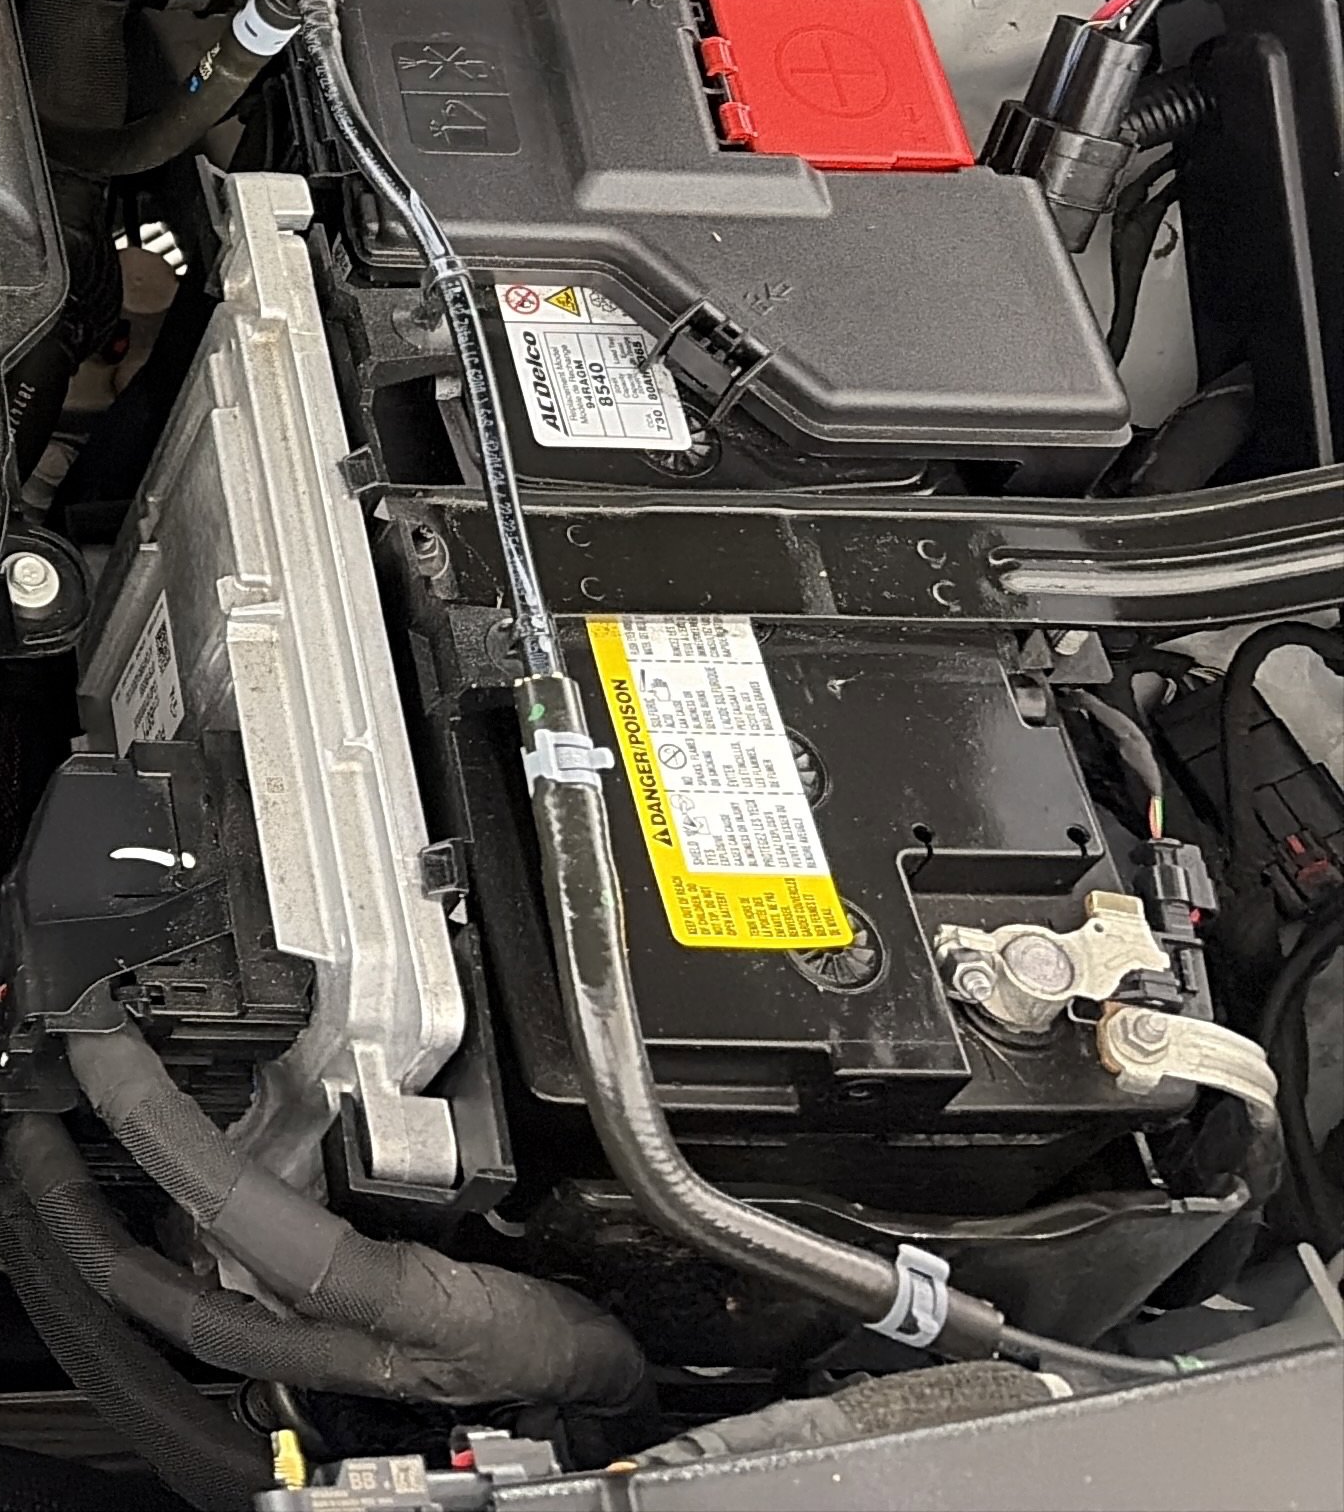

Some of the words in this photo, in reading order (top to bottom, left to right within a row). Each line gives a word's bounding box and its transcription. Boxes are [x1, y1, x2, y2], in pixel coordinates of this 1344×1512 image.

[549, 346, 564, 370] Model
[559, 344, 578, 382] Rechange
[609, 349, 620, 364] Load
[465, 367, 484, 394] 6200
[523, 331, 560, 432] ACDelco
[570, 384, 580, 394] de
[572, 358, 595, 409] 94RAGM
[586, 361, 614, 407] 8540
[616, 372, 631, 398] Capacity
[556, 371, 578, 421] Replacement
[644, 412, 655, 428] CCA
[651, 409, 668, 432] 730
[682, 690, 693, 698] OR
[703, 666, 726, 704] SULFURIQUE
[748, 680, 765, 701] GRAVES
[671, 699, 685, 716] CAUSE
[685, 699, 703, 729] BLINDNESS
[701, 709, 716, 729] SEVERE
[662, 713, 677, 728] ACID
[676, 717, 689, 728] CAN
[612, 679, 667, 826] DANGER/POISON
[683, 737, 700, 760] FLAMES
[701, 750, 718, 776] SMOKING
[761, 759, 777, 778] FUMER
[720, 764, 739, 787] ÉVITER
[740, 777, 753, 787] LES
[754, 777, 766, 787] LES
[729, 801, 745, 822] INJURY
[743, 798, 759, 816] YEUX
[719, 813, 734, 832] CAUSE
[736, 823, 748, 832] OR
[749, 817, 764, 831] LES
[777, 814, 795, 840] BLESSER
[791, 817, 809, 843] AVEUGLE
[712, 834, 731, 866] EXPLOSIVE
[725, 833, 738, 846] CAN
[739, 833, 759, 867] BLINDNESS
[753, 832, 776, 867] PROTÉGEZ
[686, 840, 705, 865] SHIELD
[702, 848, 719, 865] EYES
[776, 856, 790, 868] LES
[785, 841, 803, 868] PEUVENT
[800, 845, 817, 868] RENDRE
[670, 875, 686, 895] REACH
[783, 877, 806, 913] COUVERCLES
[679, 906, 693, 918] OUT
[714, 891, 732, 918] BATTERY
[683, 919, 698, 935] KEEP
[722, 919, 738, 936] OPEN
